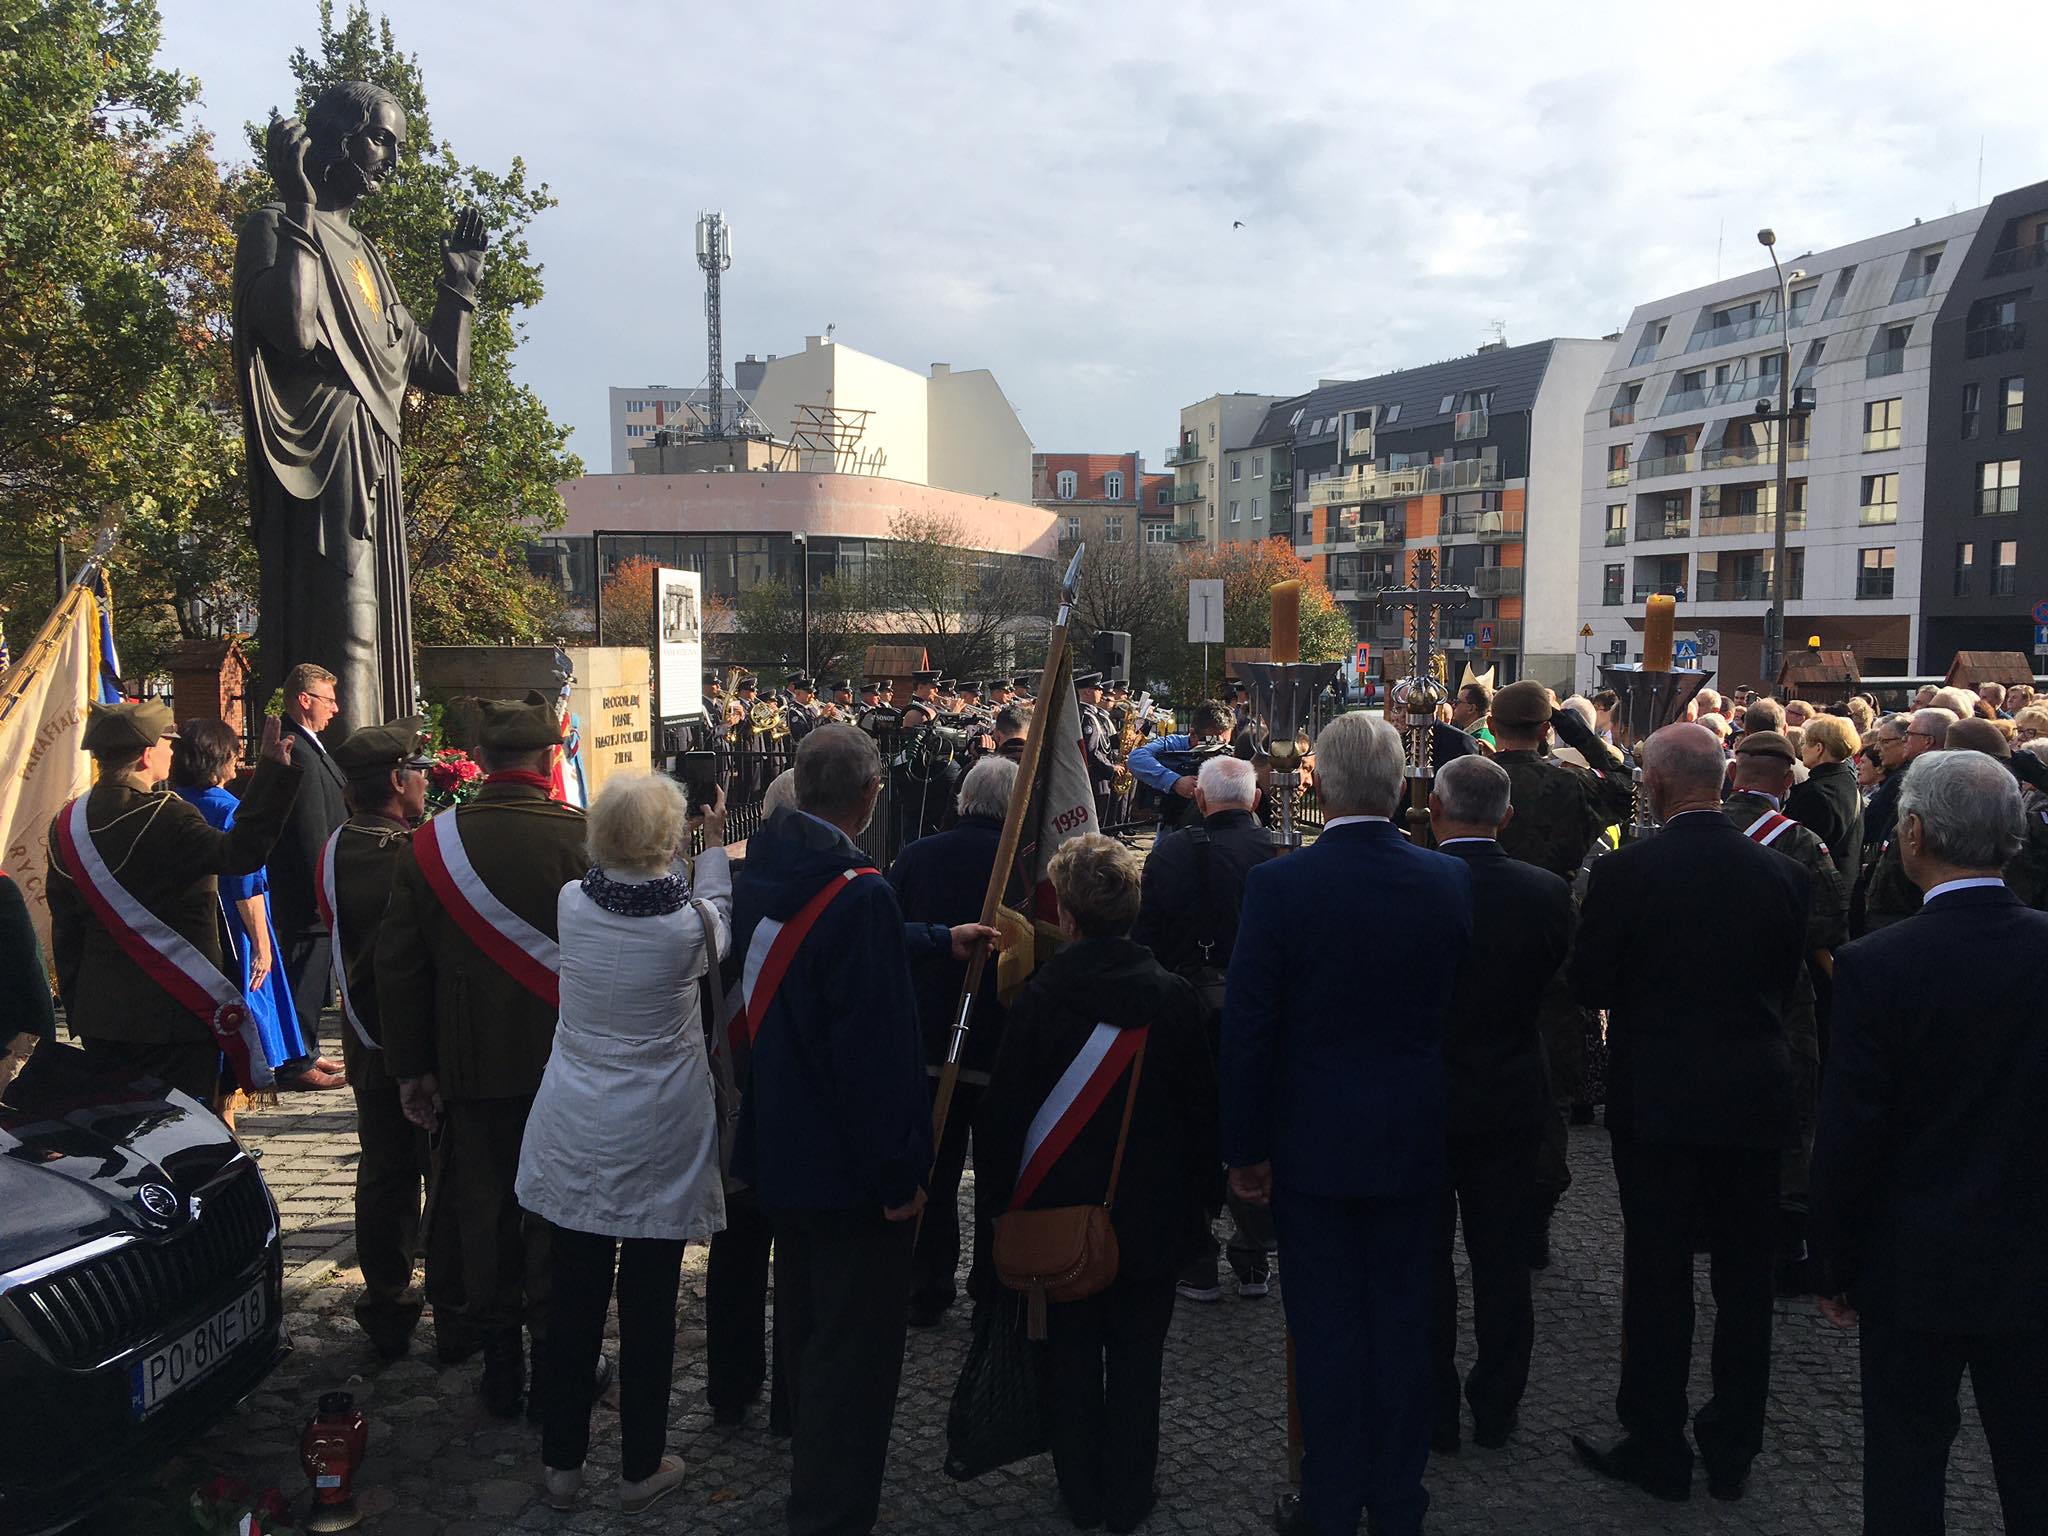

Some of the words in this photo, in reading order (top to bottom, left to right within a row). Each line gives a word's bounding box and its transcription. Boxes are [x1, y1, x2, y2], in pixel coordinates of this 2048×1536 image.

[1051, 805, 1089, 835] 1939
[150, 1343, 185, 1401] PO
[194, 1289, 261, 1369] 8NE18
[131, 1395, 144, 1408] PL
